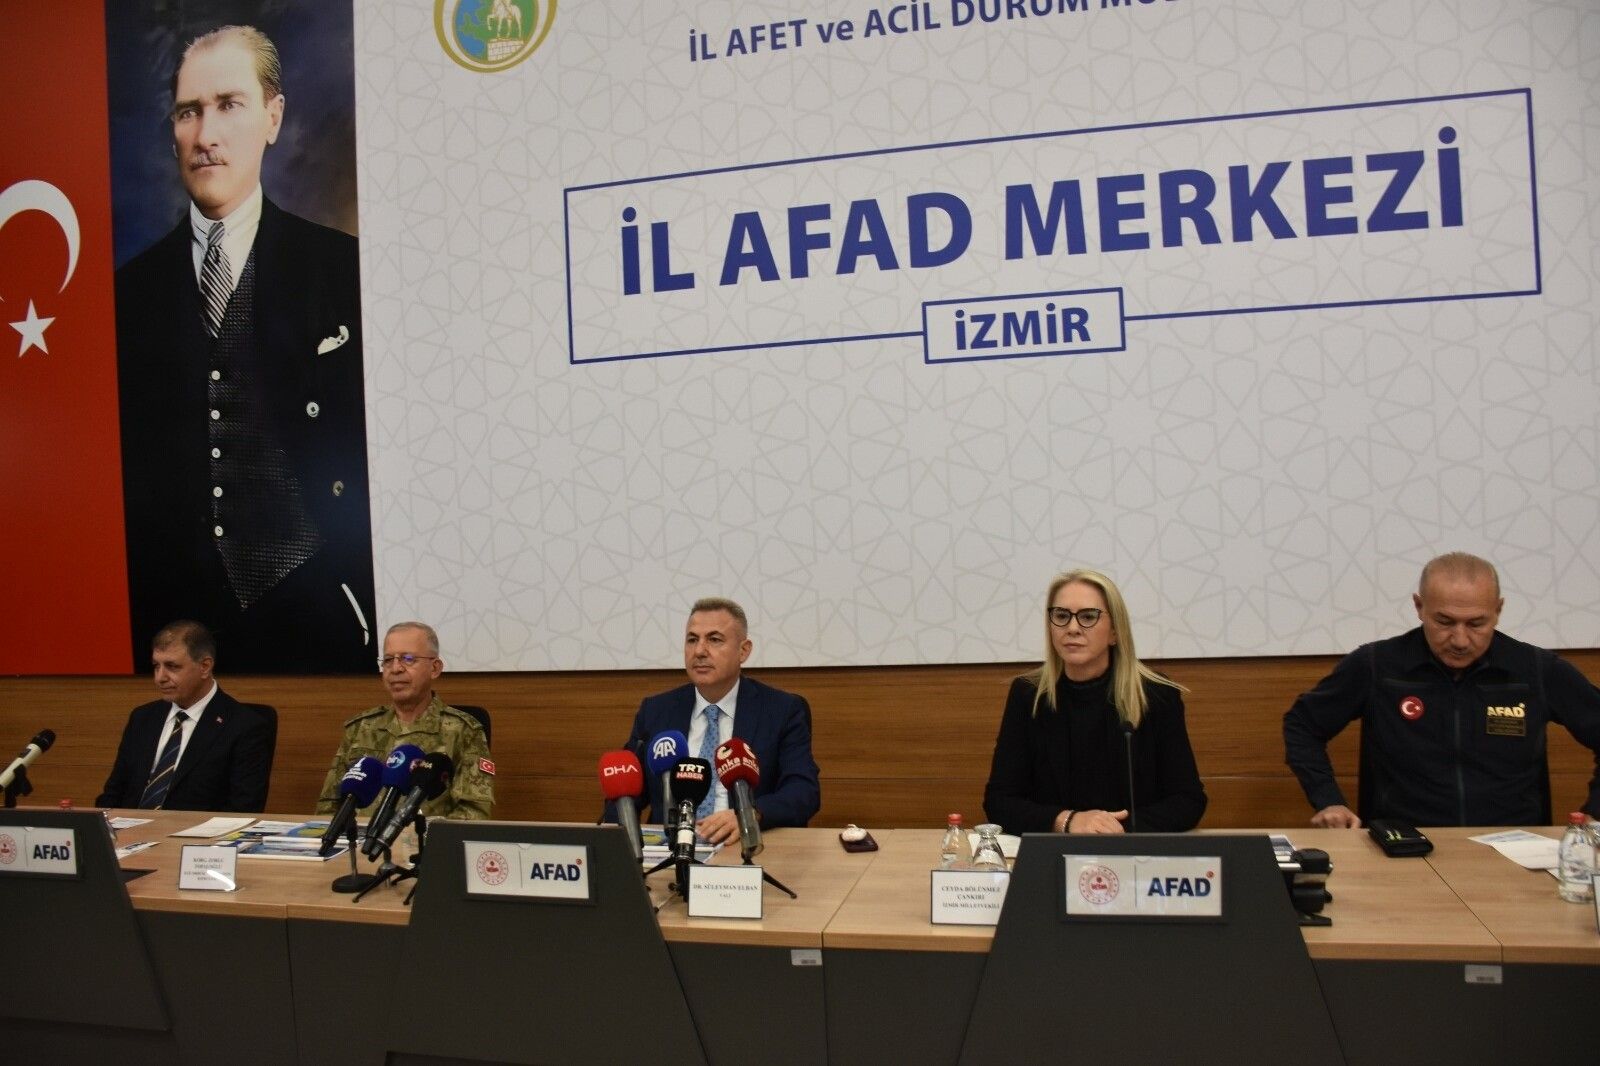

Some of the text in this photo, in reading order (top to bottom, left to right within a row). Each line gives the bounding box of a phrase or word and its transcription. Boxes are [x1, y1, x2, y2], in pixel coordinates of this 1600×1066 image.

[689, 28, 717, 61] İL
[726, 18, 807, 57] AFET
[816, 19, 854, 44] ve
[864, 0, 941, 38] ACİL
[620, 126, 1464, 296] İL AFAD MERKEZİ
[953, 302, 1092, 351] İZMİR
[1486, 706, 1526, 718] AFAD
[603, 764, 639, 777] DHA
[676, 771, 704, 781] HABER
[678, 763, 705, 773] TRT
[33, 844, 70, 861] AFAD
[530, 862, 581, 882] AFAD
[1147, 877, 1211, 897] AFAD
